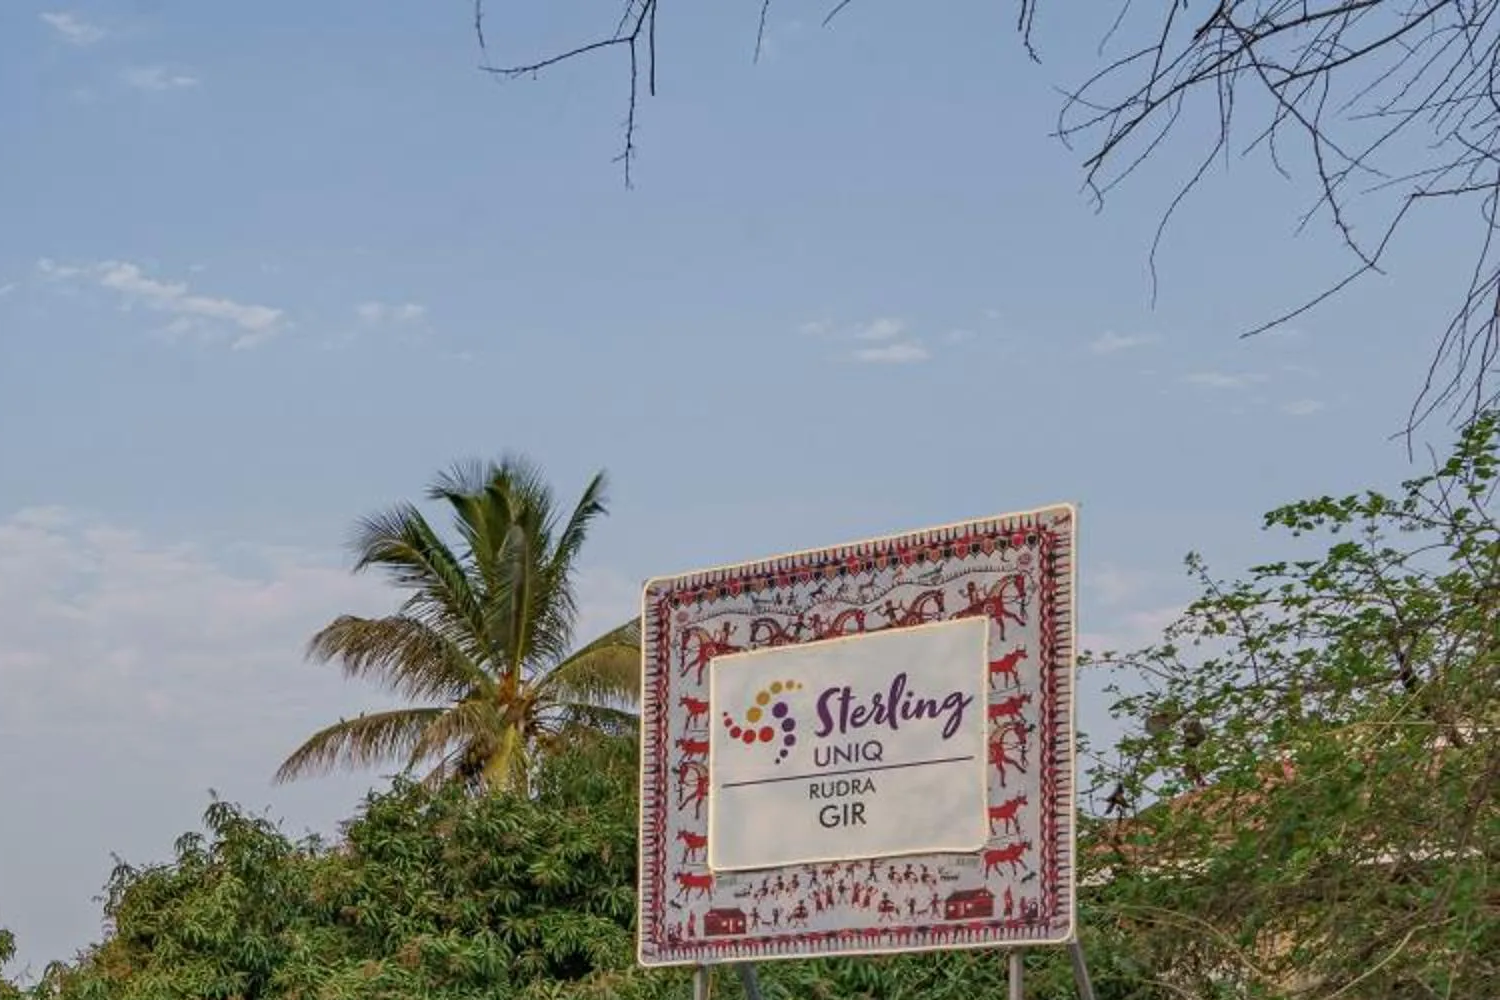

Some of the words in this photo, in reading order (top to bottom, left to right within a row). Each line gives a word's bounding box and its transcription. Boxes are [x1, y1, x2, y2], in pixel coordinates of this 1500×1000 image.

[814, 672, 974, 740] Sterling
[814, 740, 883, 767] UNIQ
[809, 777, 876, 799] RUDRA
[819, 802, 866, 828] GIR
